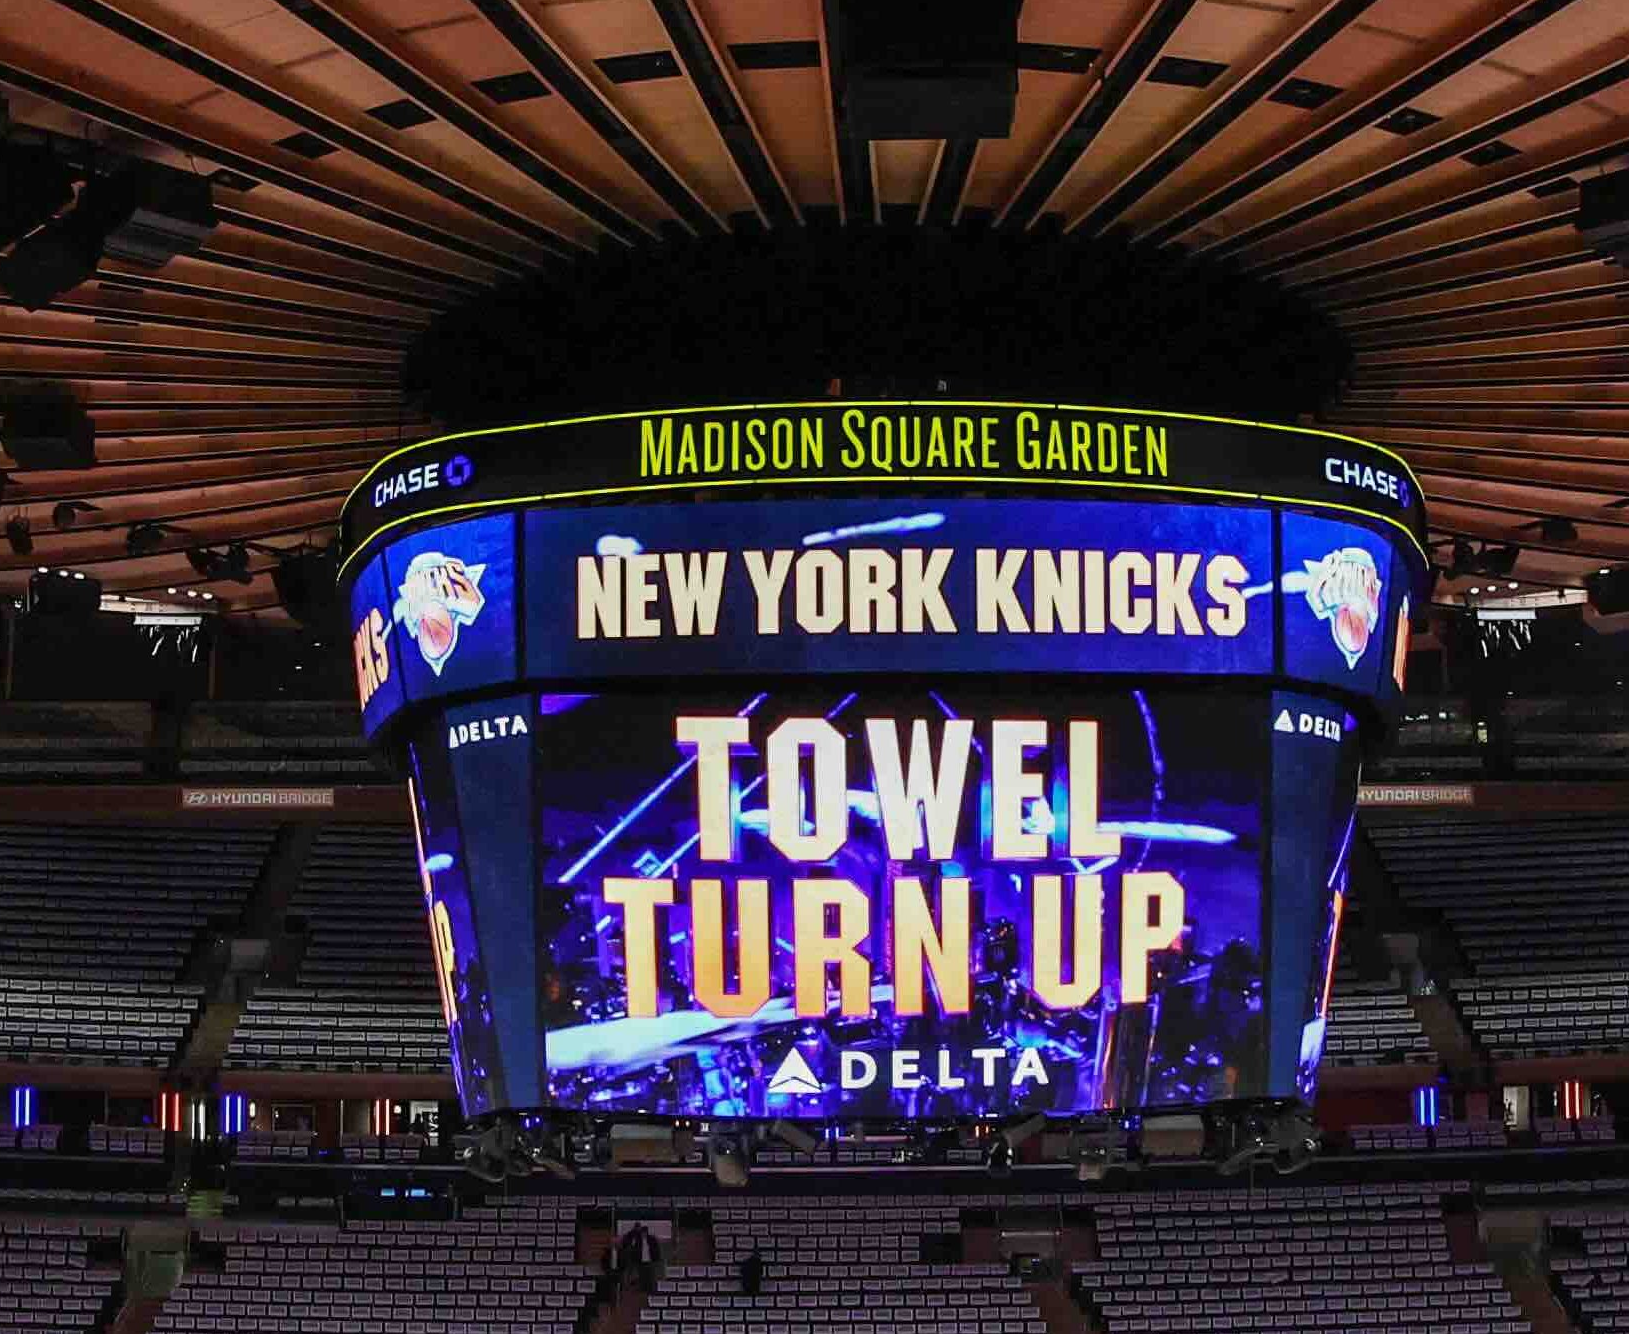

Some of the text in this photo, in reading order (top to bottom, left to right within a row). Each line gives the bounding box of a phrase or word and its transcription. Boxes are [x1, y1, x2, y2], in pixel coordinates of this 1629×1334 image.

[640, 409, 1168, 478] MADISON SQUARE GARDEN
[375, 463, 439, 507] CHASE
[1325, 458, 1399, 499] CHASE
[577, 551, 728, 639] NEW
[742, 549, 957, 634] YORK
[975, 549, 1249, 636] KNICKS
[459, 714, 528, 744] DELTA
[1299, 713, 1341, 742] DELTA
[212, 792, 333, 804] HYUNDAI BRIDGE
[675, 716, 1122, 861] TOWEL
[602, 871, 1185, 1018] TURN UP
[840, 1047, 1050, 1089] DELTA
